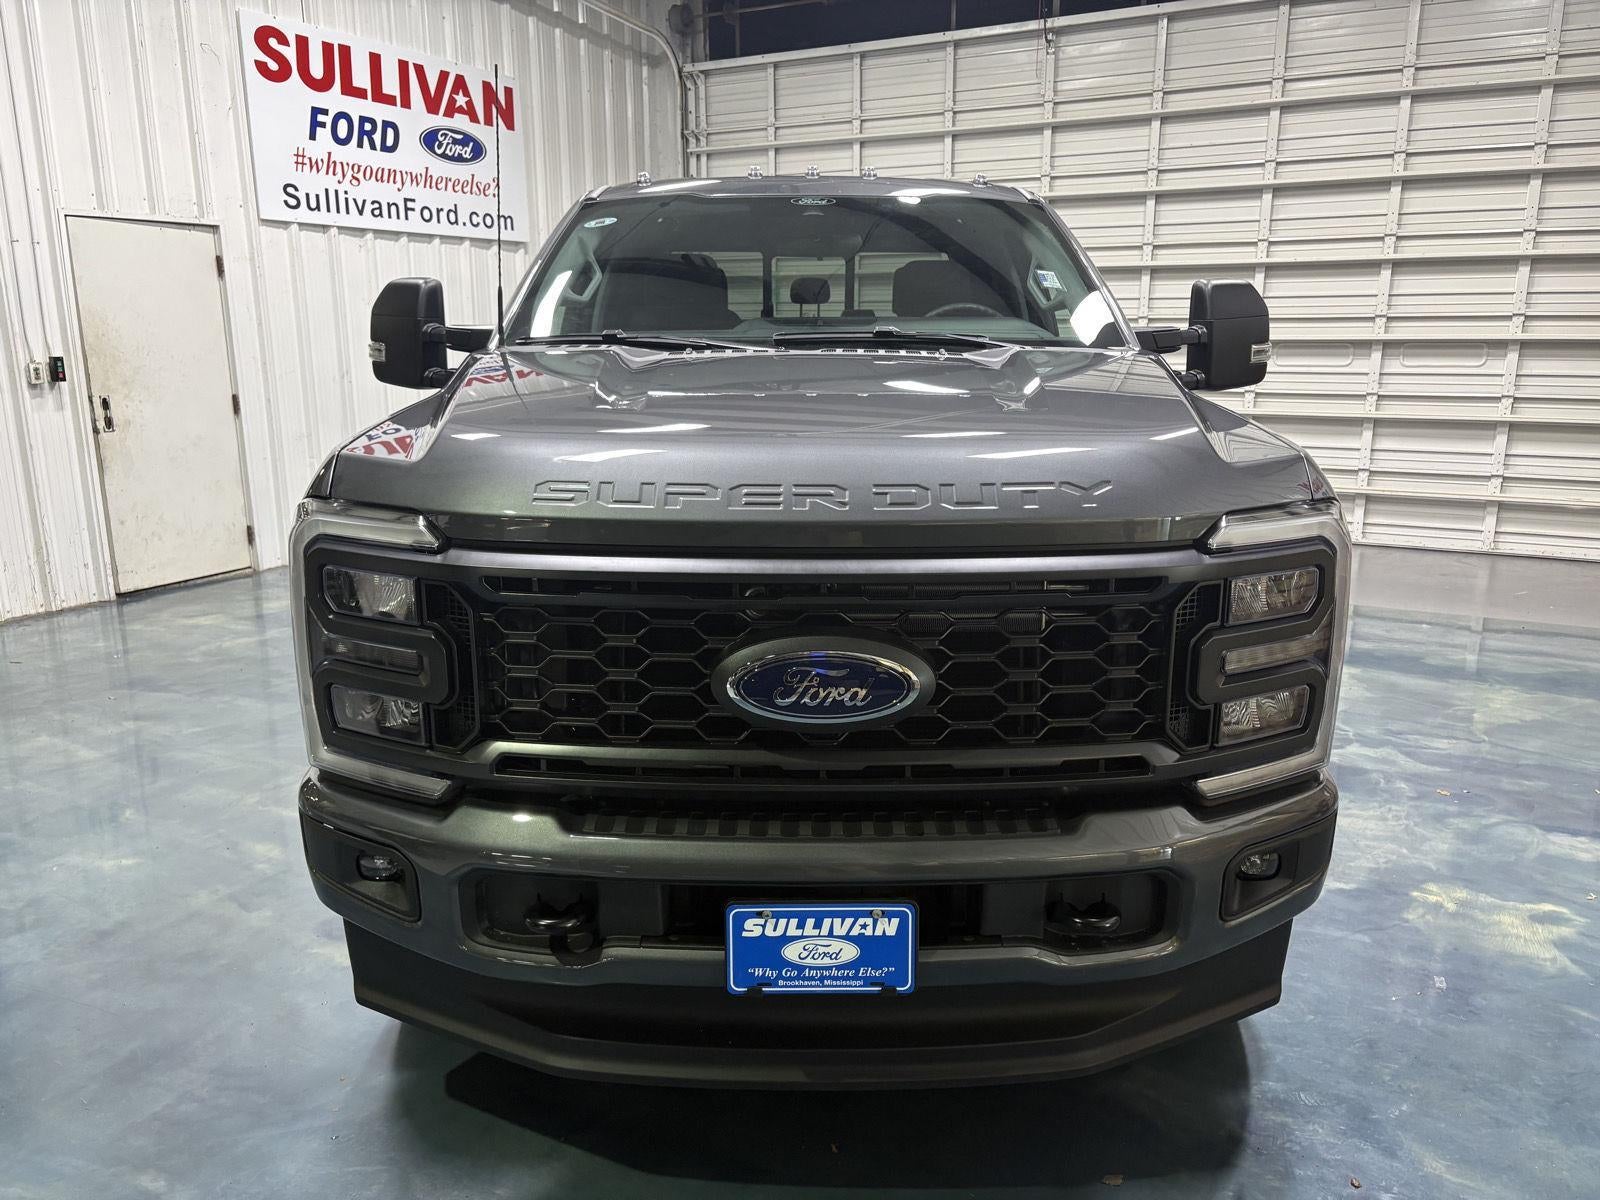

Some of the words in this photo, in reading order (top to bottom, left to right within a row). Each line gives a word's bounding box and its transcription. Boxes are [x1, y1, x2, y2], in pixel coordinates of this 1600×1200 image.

[253, 24, 516, 132] SULLIVAN
[308, 105, 400, 154] FORD
[434, 129, 474, 160] Ford
[293, 146, 500, 199] #whygoanywhereelse?
[282, 182, 515, 231] SullivanFord.com
[532, 480, 850, 512] SUPER
[872, 479, 1113, 511] DUTY
[773, 667, 876, 707] Ford
[741, 916, 900, 938] SULLIVAN
[797, 942, 844, 961] Ford
[778, 979, 823, 987] Brookhaven,
[824, 979, 864, 988] Mississippi
[782, 967, 798, 978] Go
[801, 967, 855, 979] Anywhere
